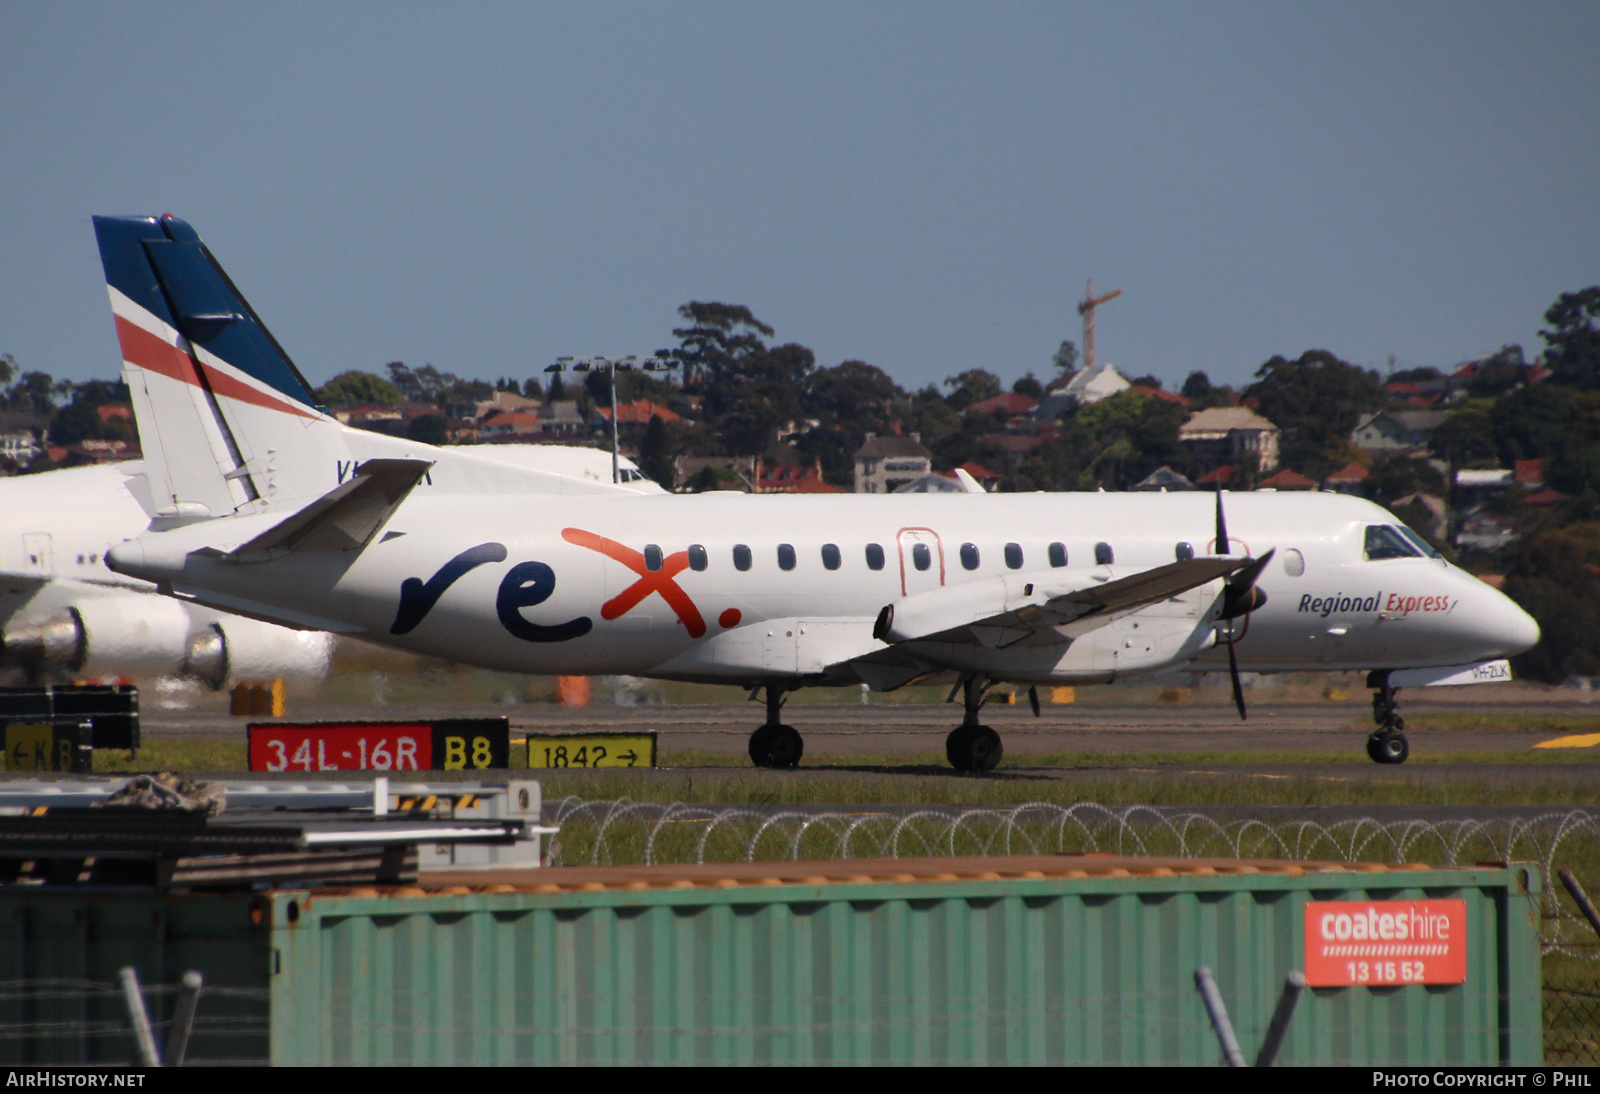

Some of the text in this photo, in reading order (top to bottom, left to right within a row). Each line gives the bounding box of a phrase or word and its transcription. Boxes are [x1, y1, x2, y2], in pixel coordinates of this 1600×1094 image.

[1299, 591, 1450, 617] Regional Express
[1472, 664, 1509, 679] VH-ZLK
[266, 736, 492, 771] 34L-16R B8
[544, 746, 608, 768] 1842
[1348, 960, 1425, 981] 13 15 52
